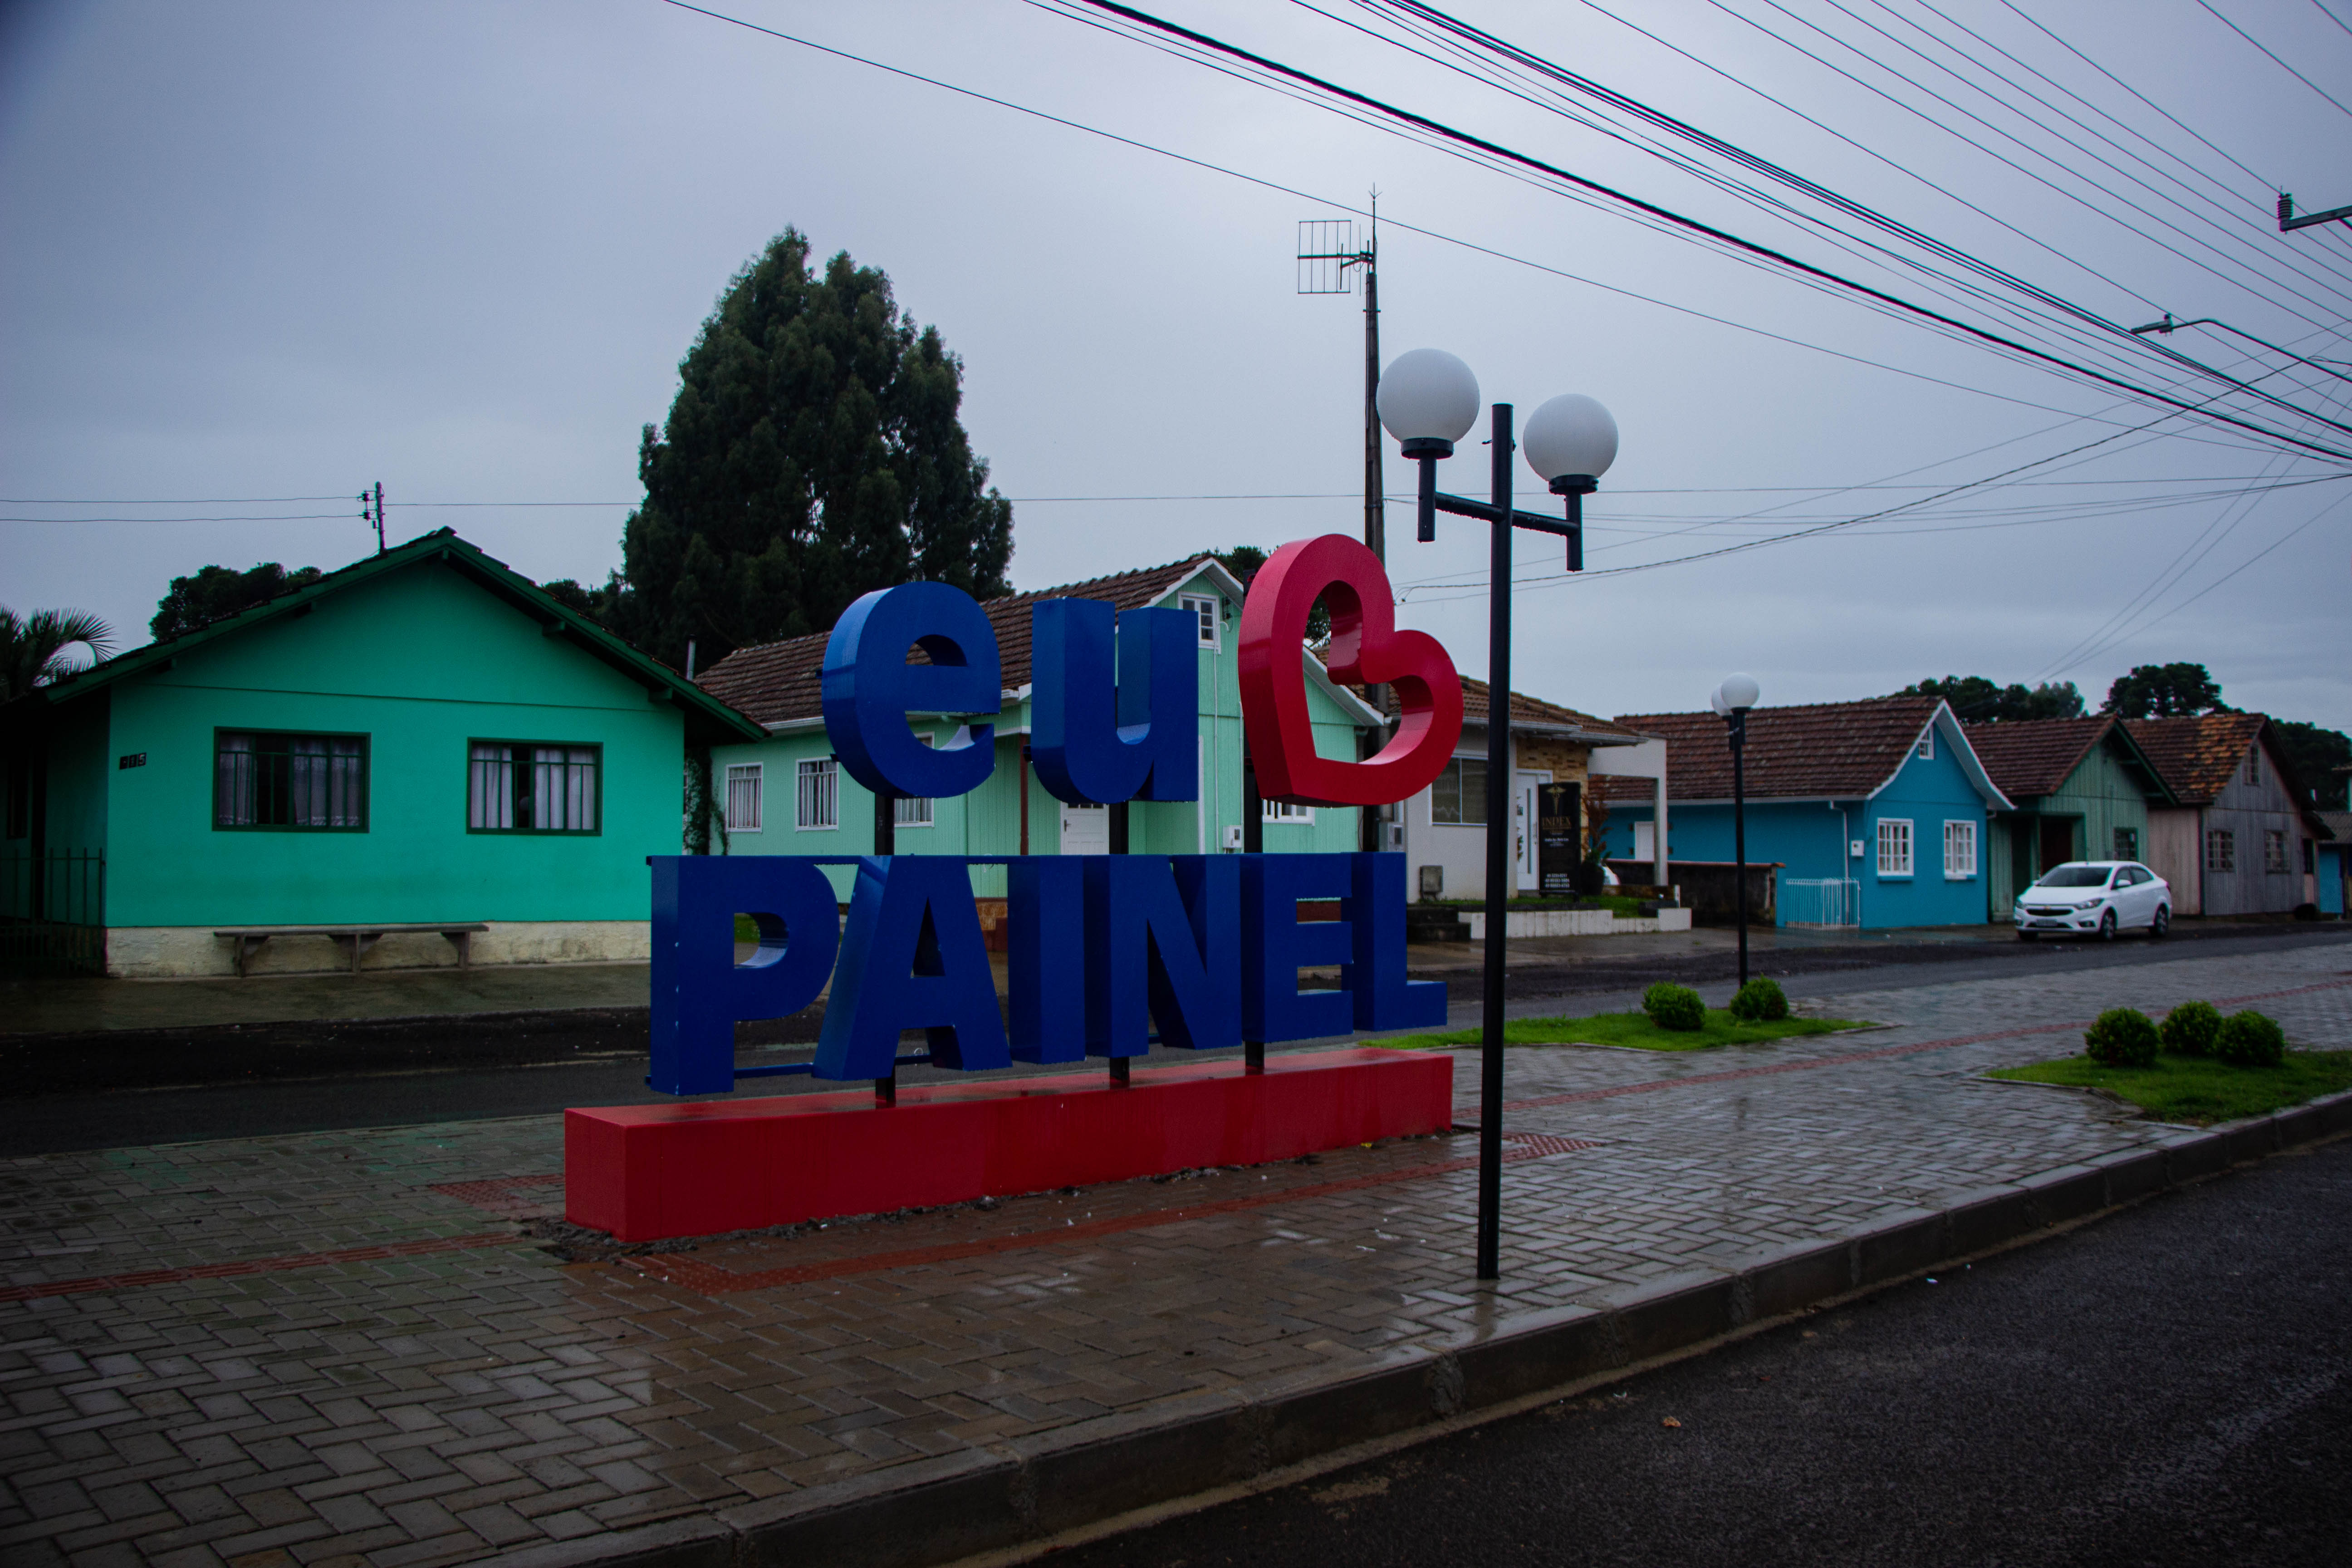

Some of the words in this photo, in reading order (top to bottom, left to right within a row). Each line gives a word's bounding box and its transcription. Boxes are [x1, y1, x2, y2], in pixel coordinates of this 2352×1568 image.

[822, 581, 1199, 804] eu
[1542, 817, 1571, 825] INDEX
[651, 852, 1447, 1095] PAINEL
